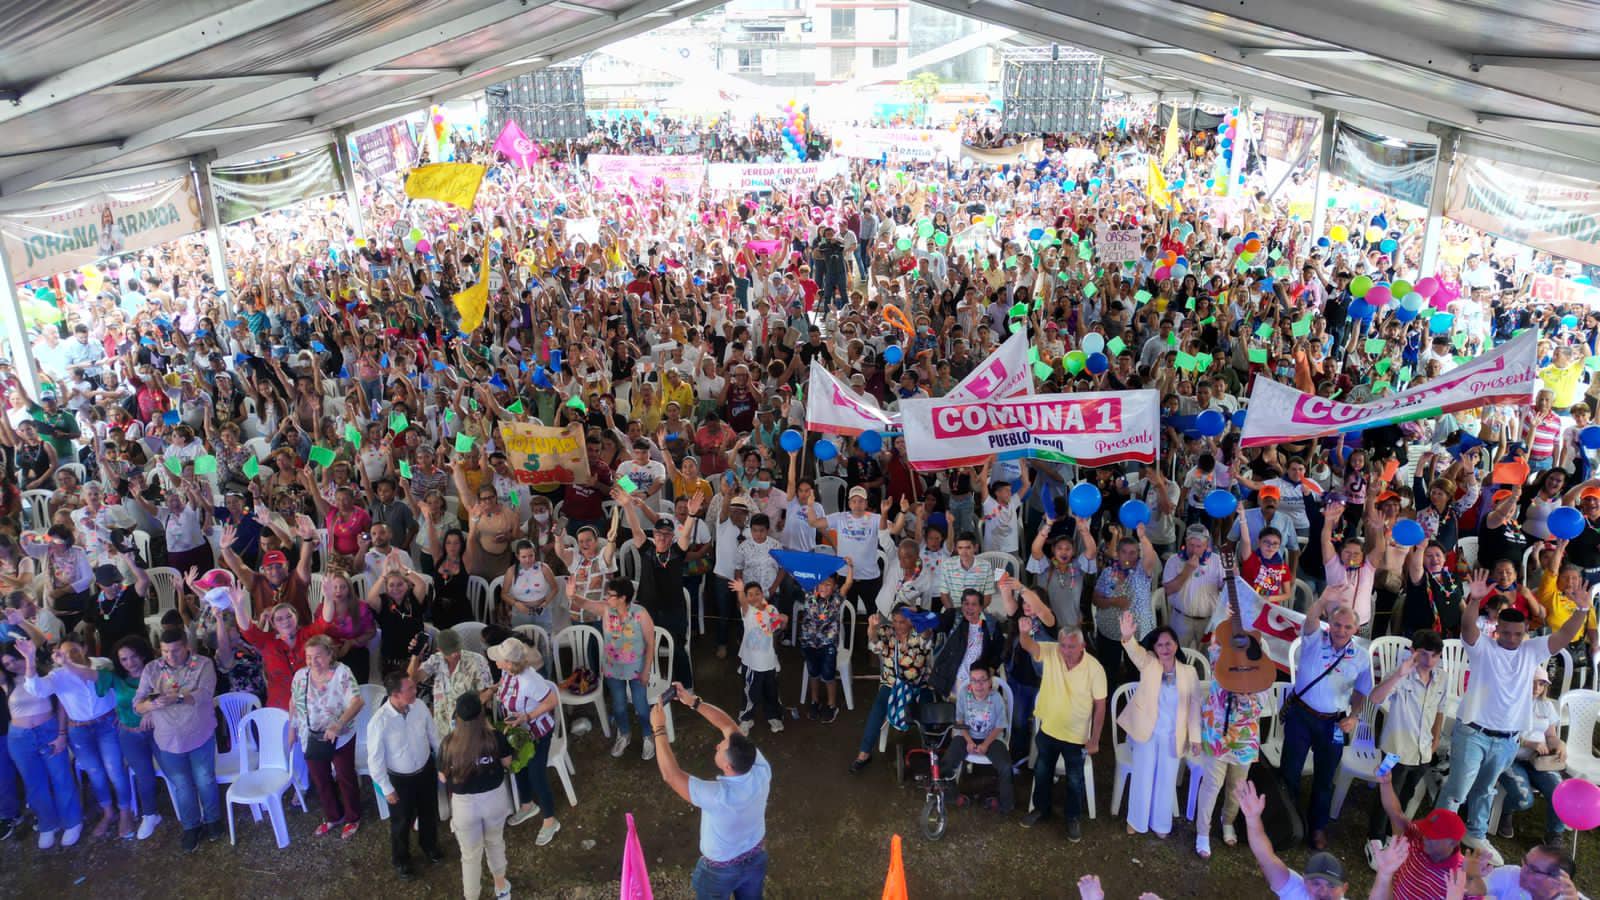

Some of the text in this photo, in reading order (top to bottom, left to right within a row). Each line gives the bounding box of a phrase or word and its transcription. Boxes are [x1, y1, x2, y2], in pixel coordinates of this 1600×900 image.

[51, 207, 84, 223] FELIZ
[24, 202, 182, 267] JOHANA ARANDA
[1105, 231, 1131, 242] OASIS
[1530, 277, 1576, 301] Feliz
[937, 402, 1116, 433] COMUNA 1
[989, 431, 1031, 449] PUEBLO
[523, 454, 540, 471] 5
